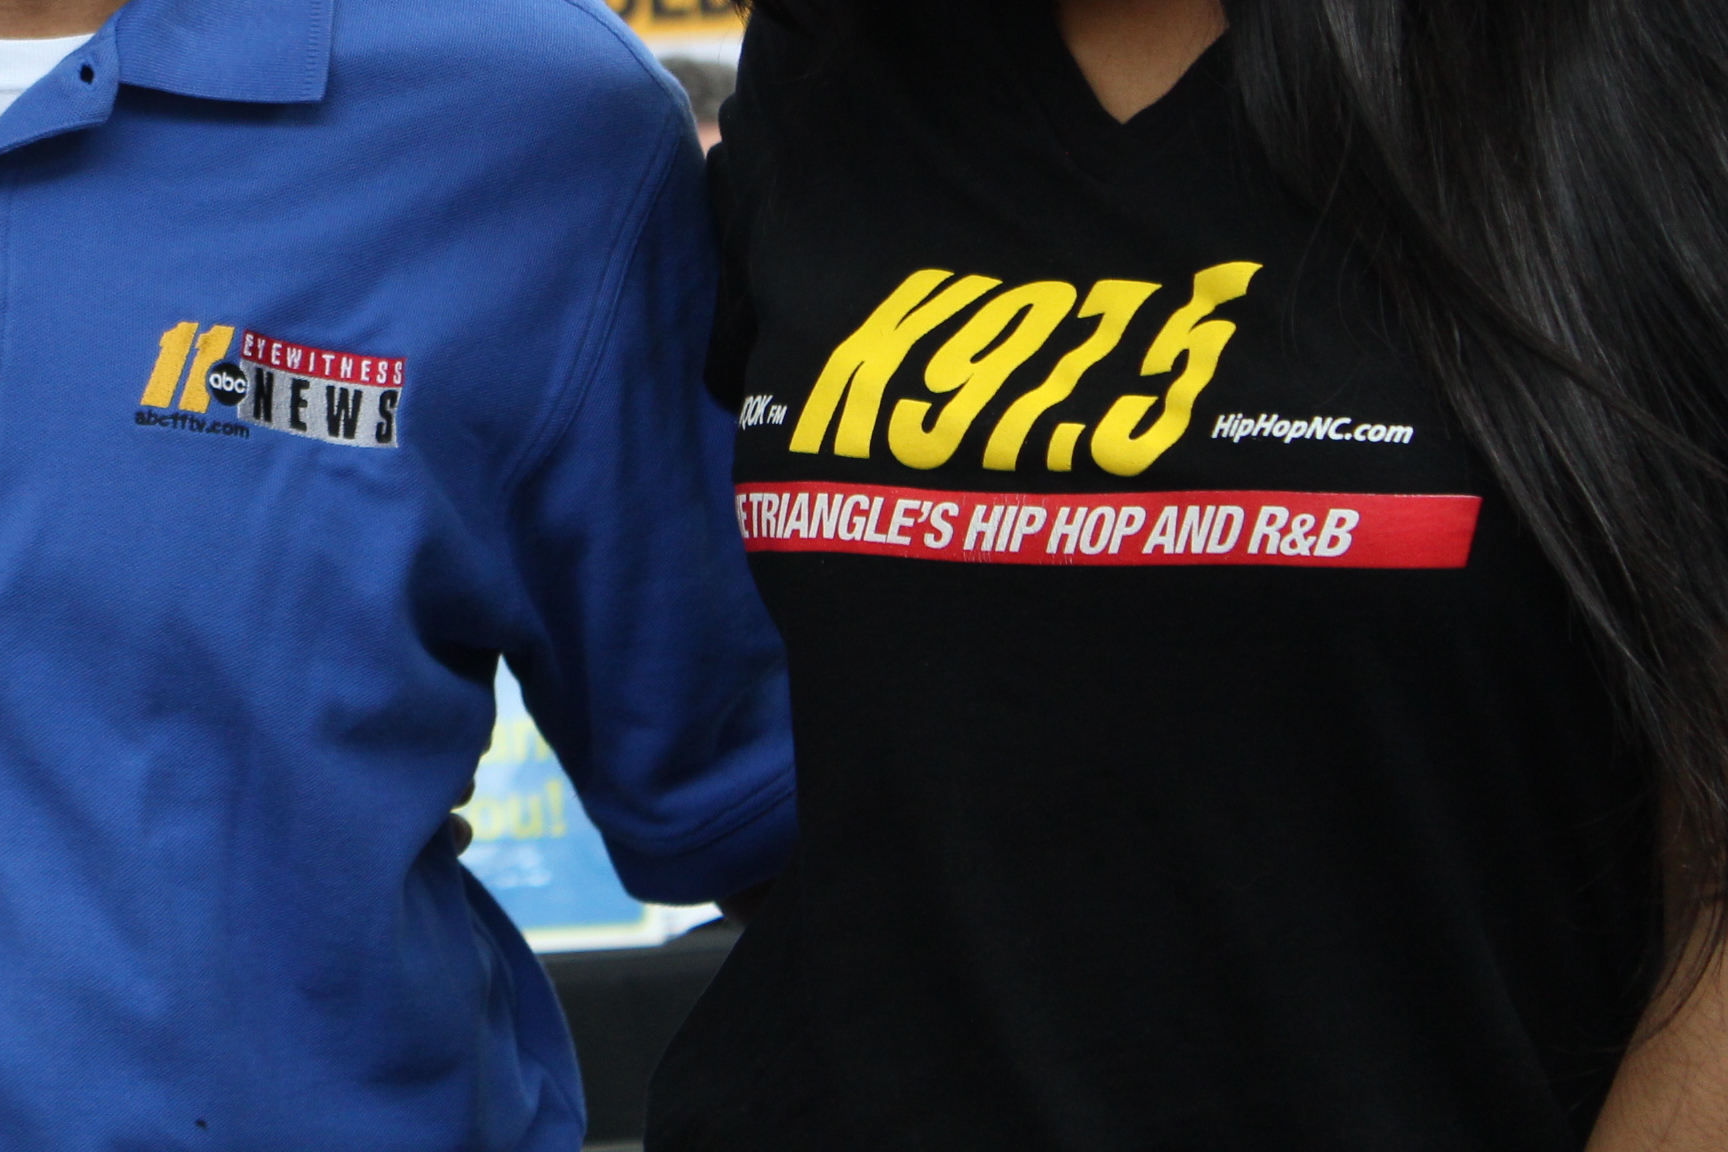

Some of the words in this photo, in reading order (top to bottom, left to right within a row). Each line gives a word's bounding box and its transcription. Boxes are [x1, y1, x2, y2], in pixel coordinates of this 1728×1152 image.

[139, 321, 235, 414] 11
[208, 372, 247, 394] abc
[243, 332, 403, 385] EYEWITNESS
[789, 261, 1263, 477] K97.5
[252, 367, 399, 444] NEWS
[767, 404, 788, 425] FM
[1210, 413, 1414, 444] HipHopNC.com
[748, 492, 960, 550] TRIANGLE'S
[964, 502, 1043, 552] HIP
[1047, 504, 1144, 556] HOP
[1143, 507, 1242, 556] AND
[1246, 506, 1362, 559] R&B
